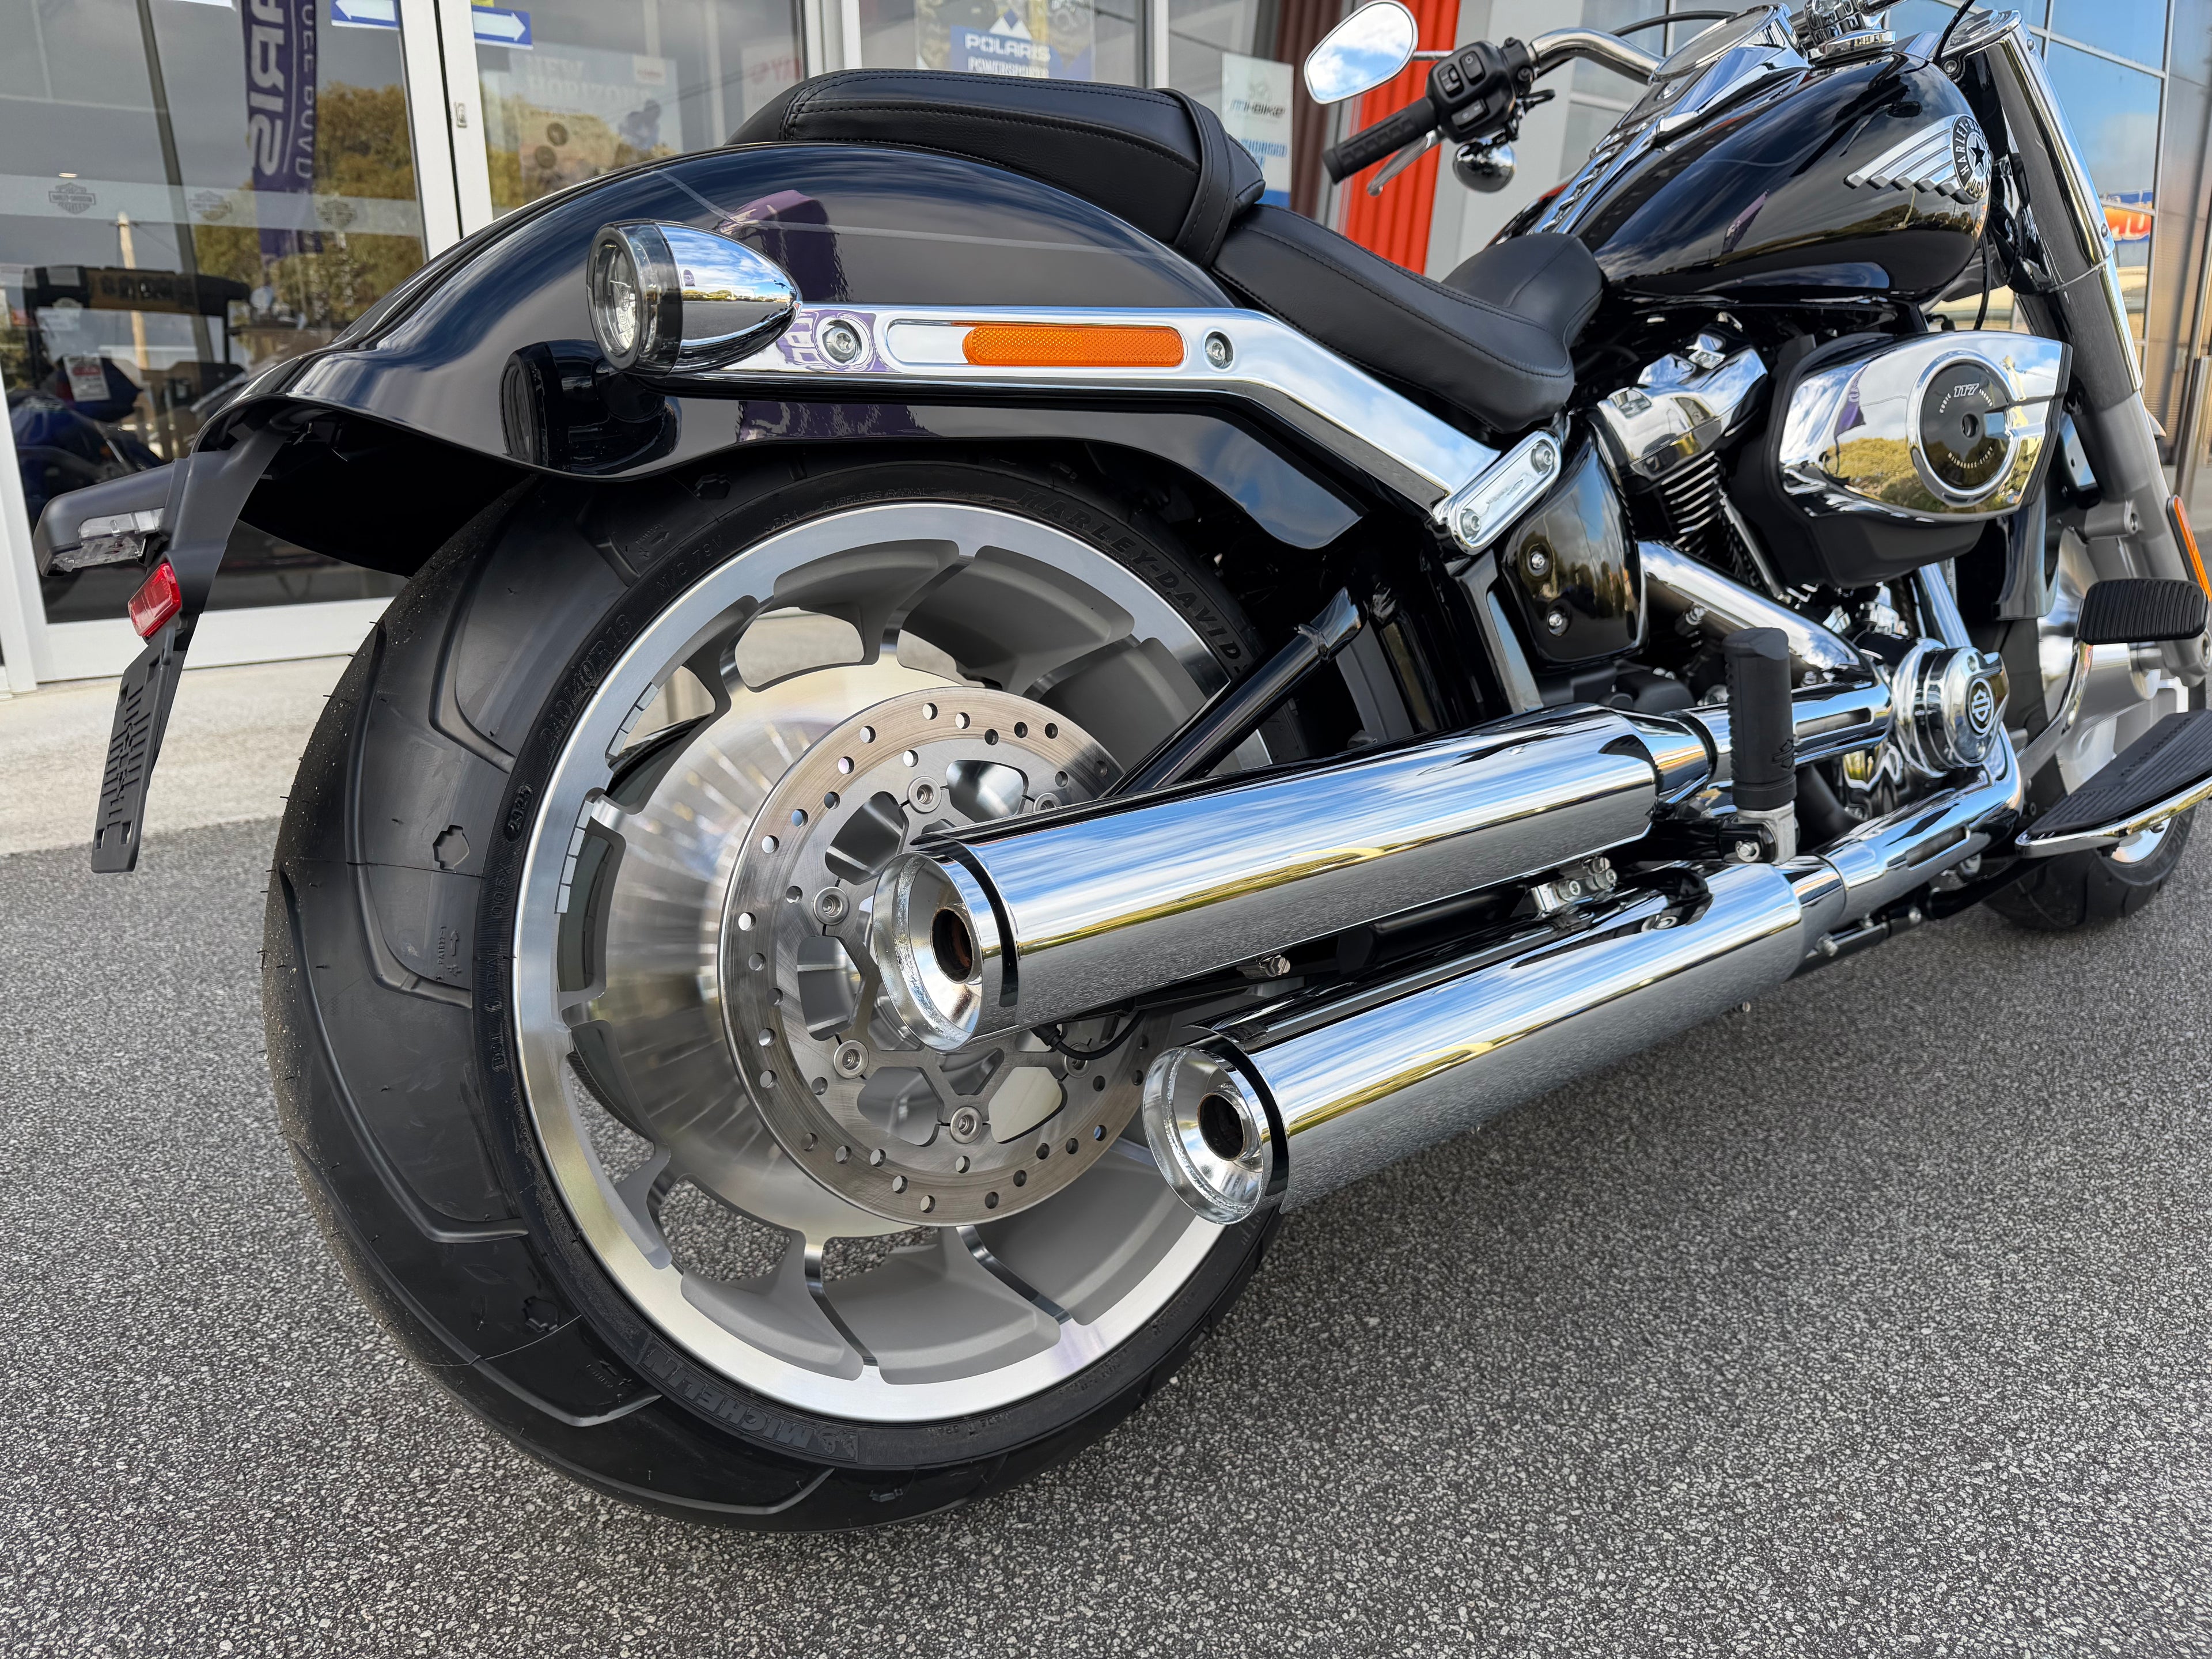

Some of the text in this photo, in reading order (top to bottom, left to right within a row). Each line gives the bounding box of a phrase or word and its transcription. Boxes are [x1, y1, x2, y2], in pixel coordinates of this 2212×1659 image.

[965, 33, 1051, 62] POLARIS
[1970, 177, 1984, 194] USA
[1939, 388, 1993, 414] CUBIC INCHES
[1953, 383, 1979, 398] 117
[1017, 488, 1249, 675] HARLEY-DAVID
[641, 1349, 816, 1449] MICHELIN
